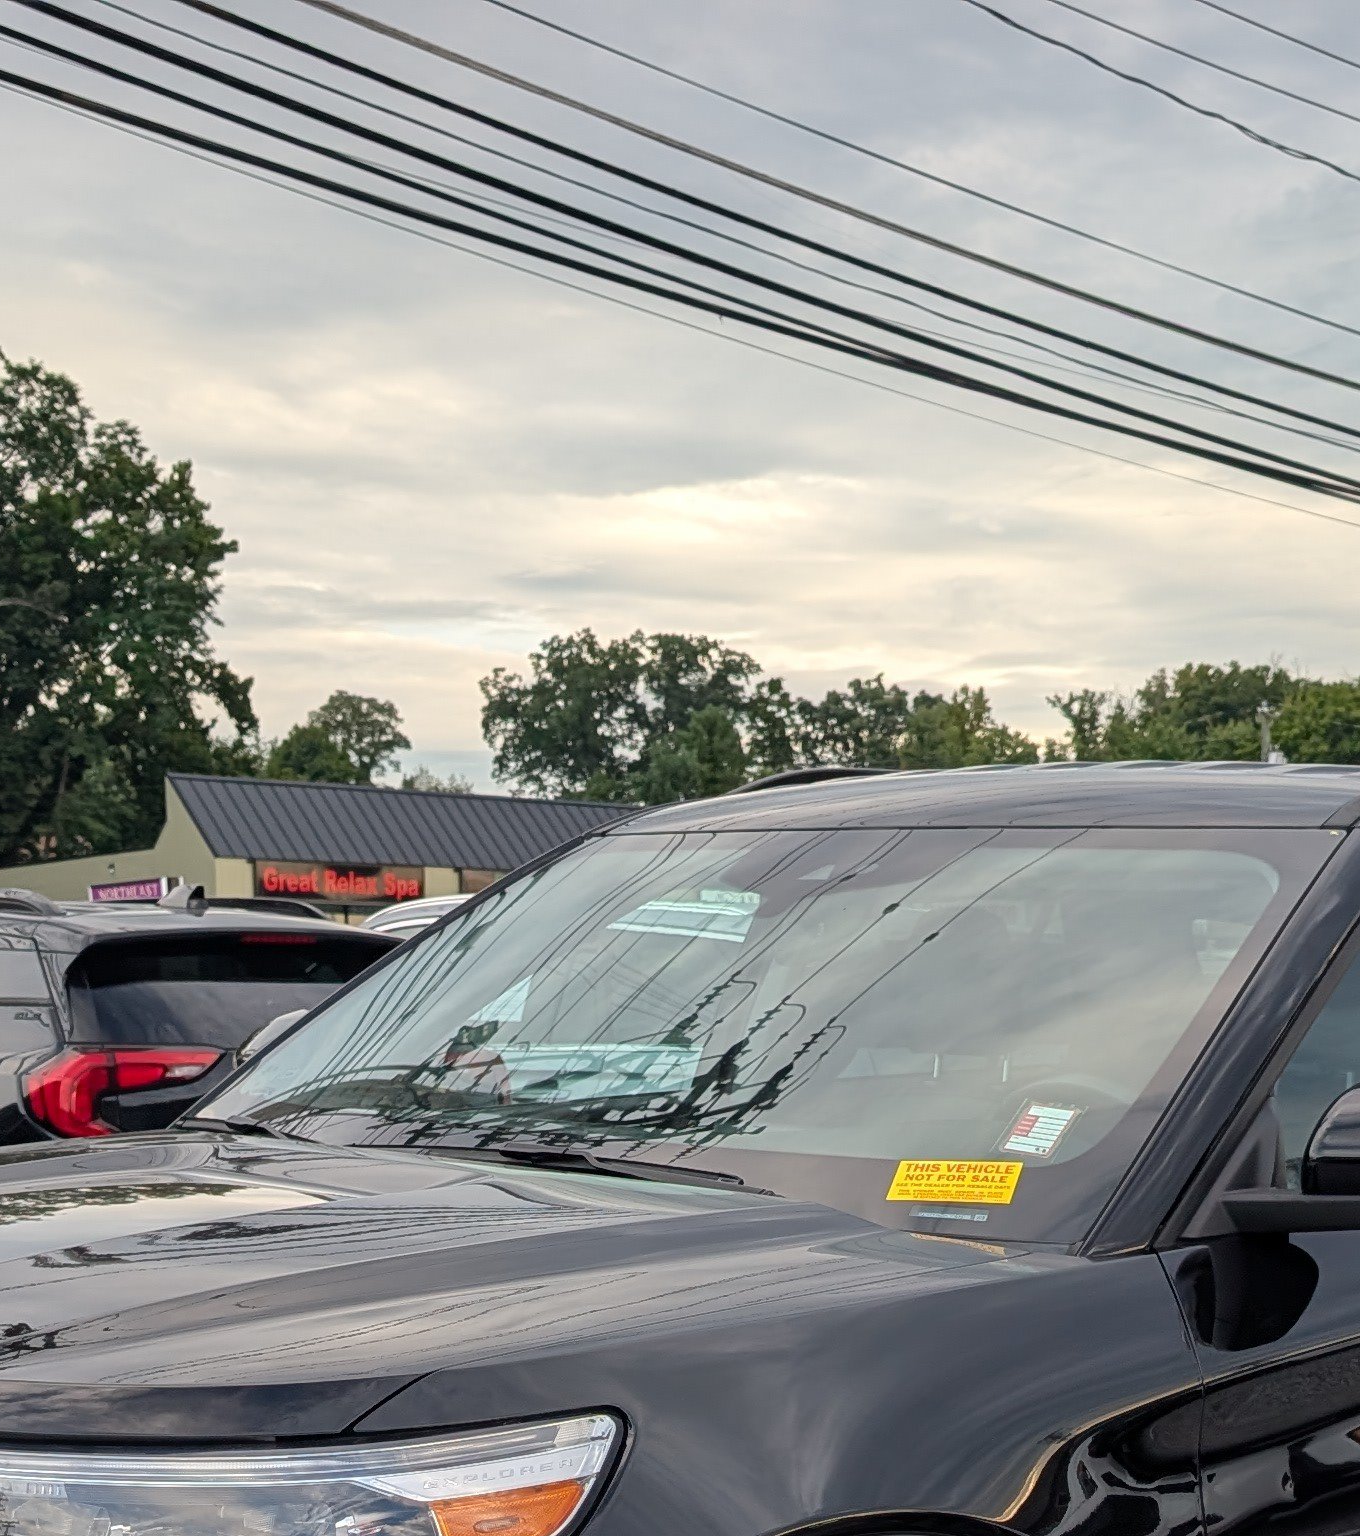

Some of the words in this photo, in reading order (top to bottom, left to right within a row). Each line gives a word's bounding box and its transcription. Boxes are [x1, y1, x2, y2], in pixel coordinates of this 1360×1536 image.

[263, 866, 319, 892] Great
[324, 869, 378, 895] Relax
[383, 871, 420, 901] Spa
[904, 1173, 935, 1181] NOT
[937, 1174, 967, 1182] FOR
[970, 1175, 1009, 1184] SALE
[905, 1163, 942, 1173] THIS
[946, 1163, 1016, 1175] VEHICLE
[422, 1458, 573, 1490] EXPLORER
